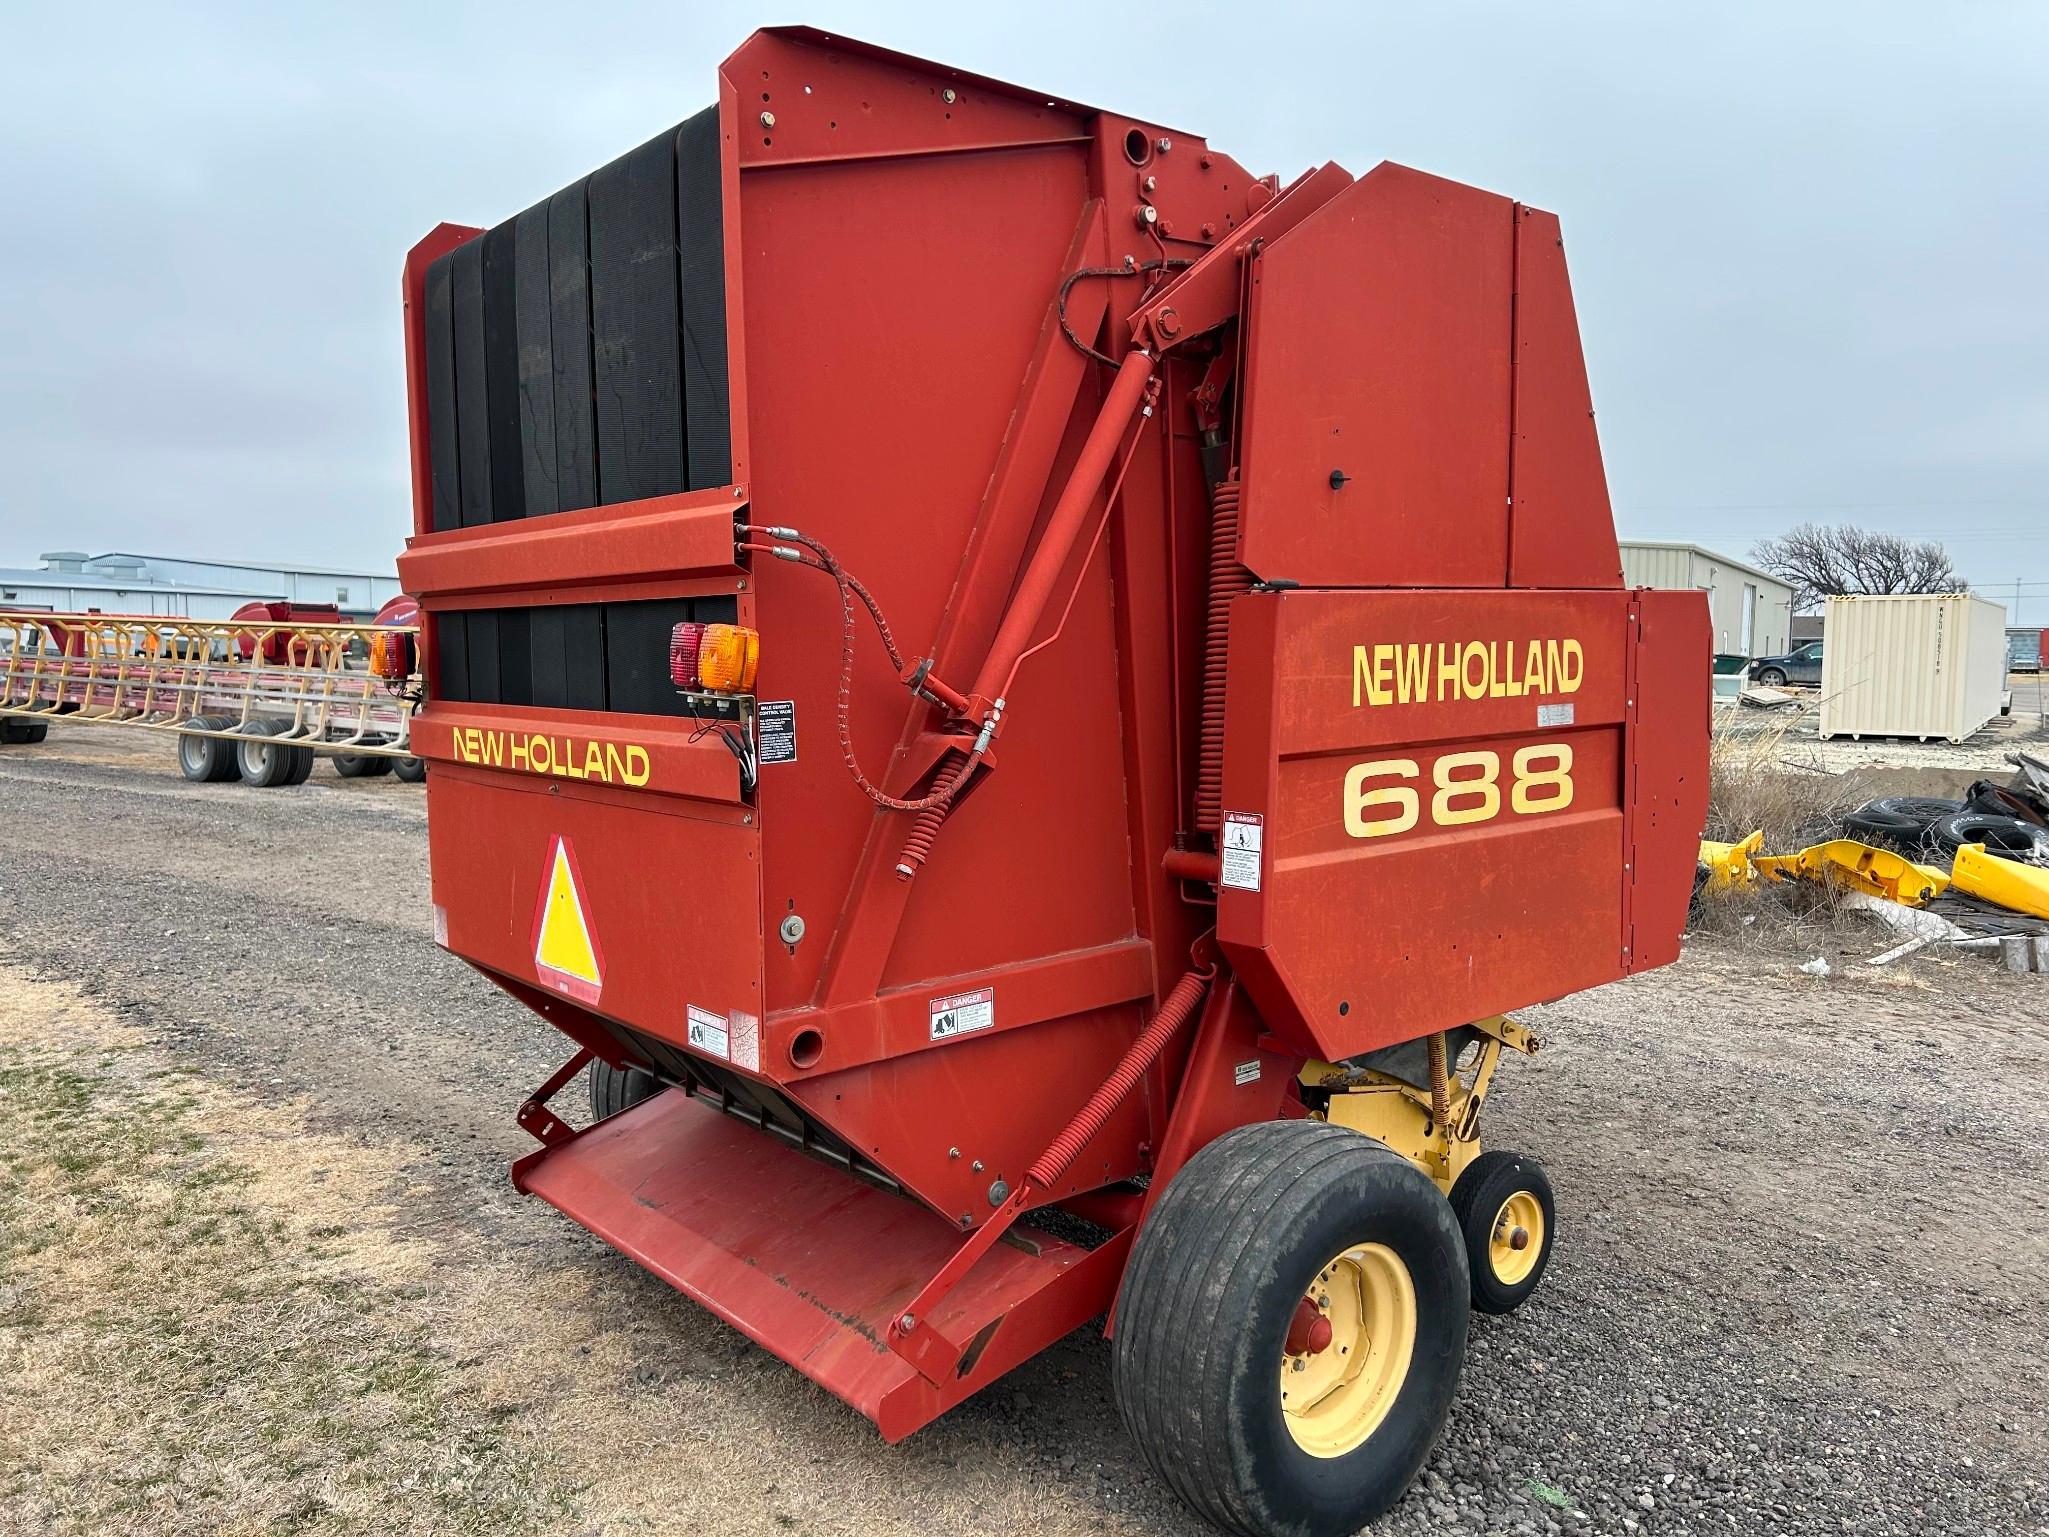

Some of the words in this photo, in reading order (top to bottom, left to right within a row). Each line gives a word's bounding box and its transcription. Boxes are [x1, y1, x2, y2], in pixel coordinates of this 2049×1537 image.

[1352, 643, 1432, 707] NEW
[1437, 639, 1584, 702] HOLLAND
[453, 727, 504, 767] NEW
[510, 733, 650, 787] HOLLAND
[1235, 815, 1257, 823] DANGER
[1344, 743, 1574, 838] 688
[952, 993, 982, 1007] DANGER
